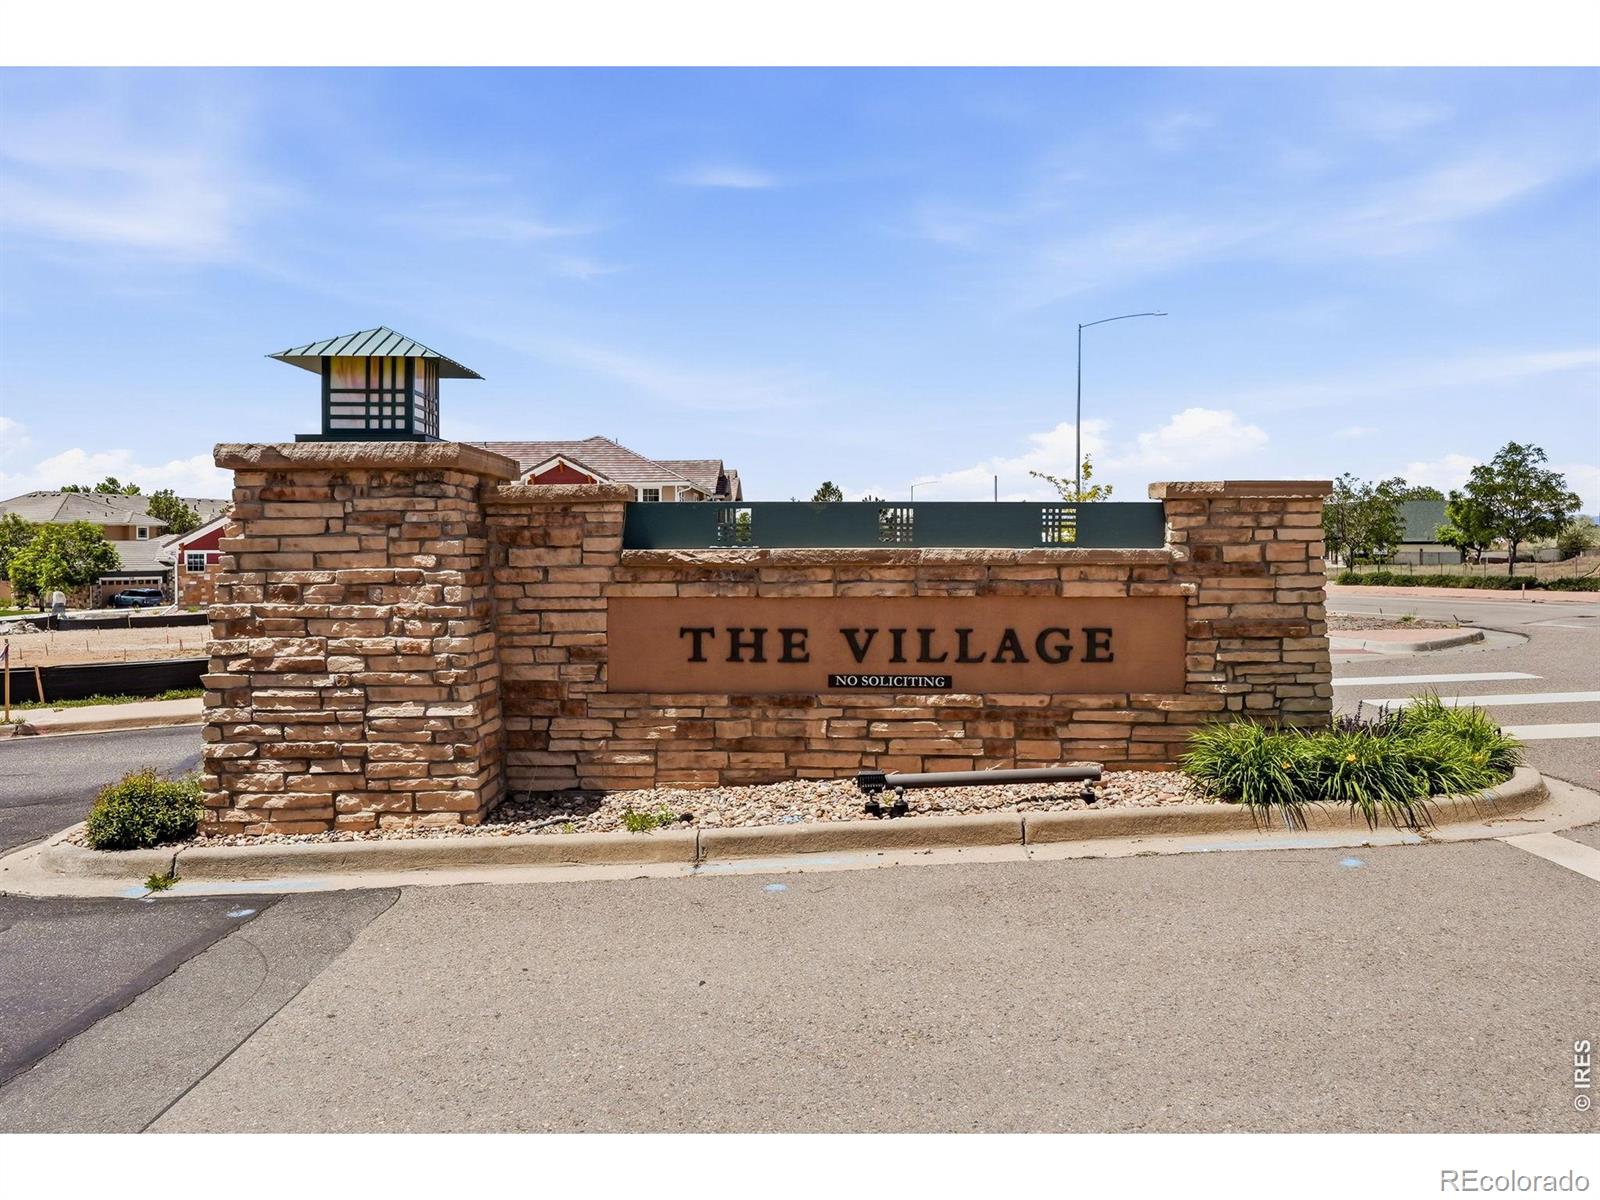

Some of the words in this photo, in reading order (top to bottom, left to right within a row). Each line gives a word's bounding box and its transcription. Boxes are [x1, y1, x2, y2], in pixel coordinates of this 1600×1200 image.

[679, 626, 810, 664] THE
[839, 626, 1115, 665] VILLAGE
[835, 675, 858, 686] NO
[861, 675, 946, 688] SOLICITING
